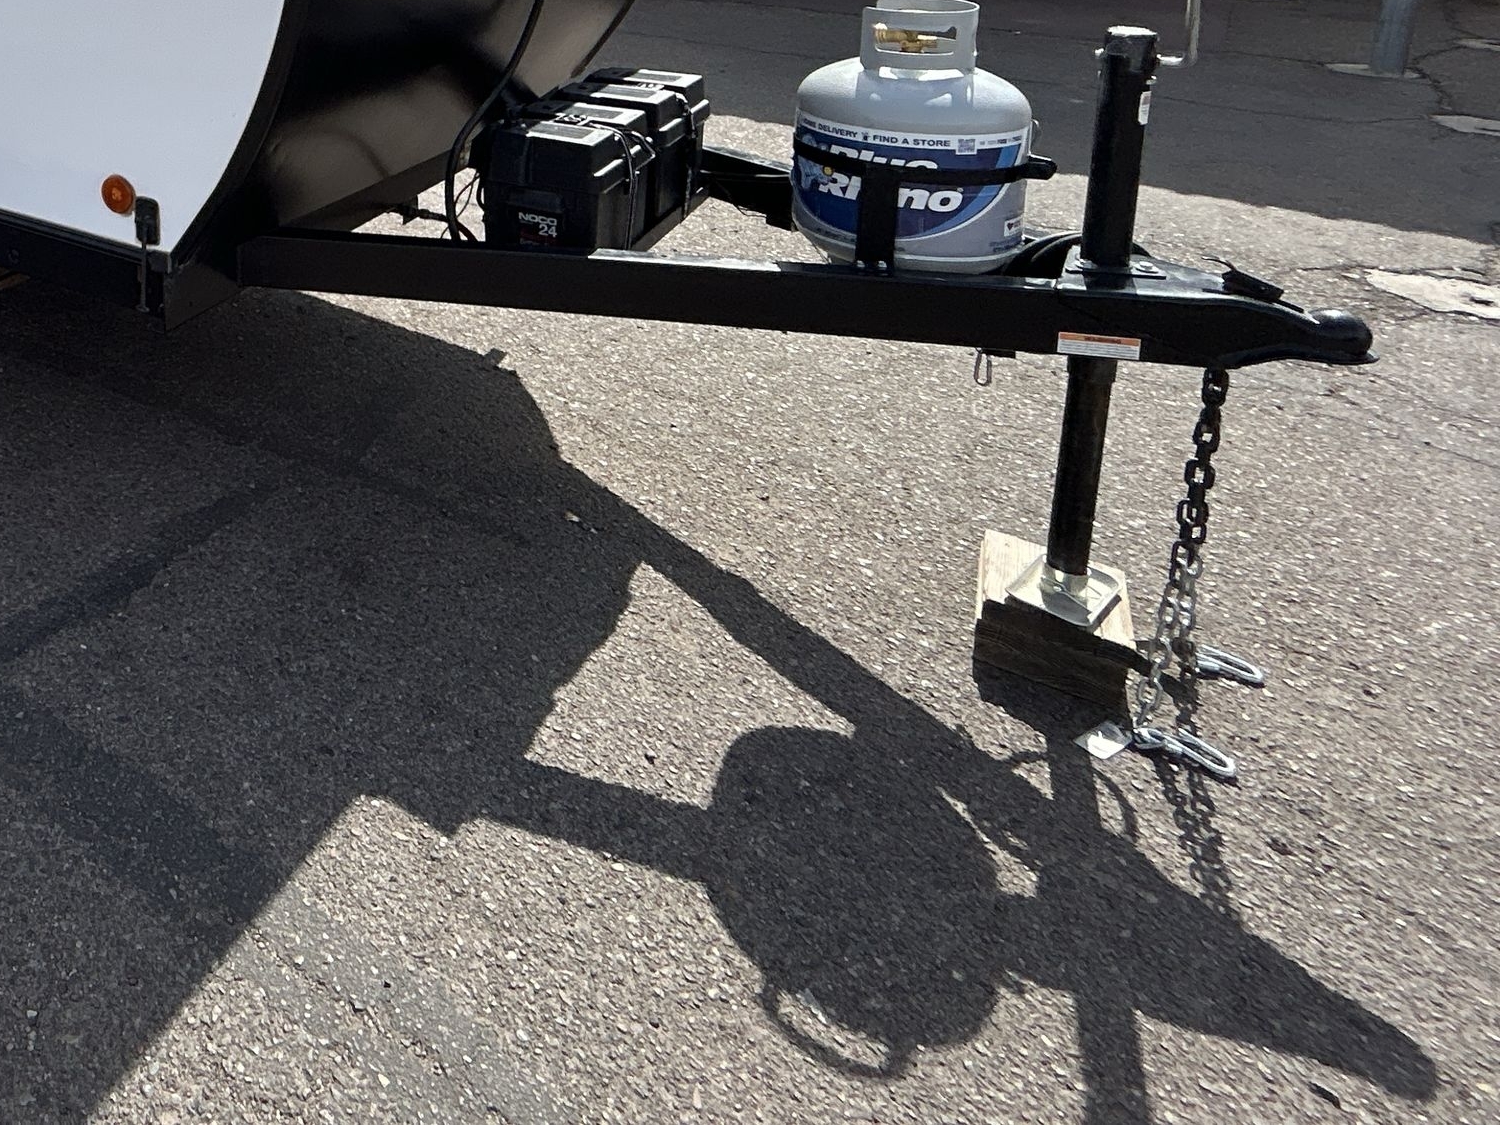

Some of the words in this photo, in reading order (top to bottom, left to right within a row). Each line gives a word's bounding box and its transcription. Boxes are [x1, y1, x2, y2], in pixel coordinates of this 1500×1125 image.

[819, 123, 858, 138] DELIVERY
[872, 134, 898, 144] FIND
[912, 138, 951, 147] STORE
[518, 211, 557, 226] NOCO
[538, 223, 557, 238] 24
